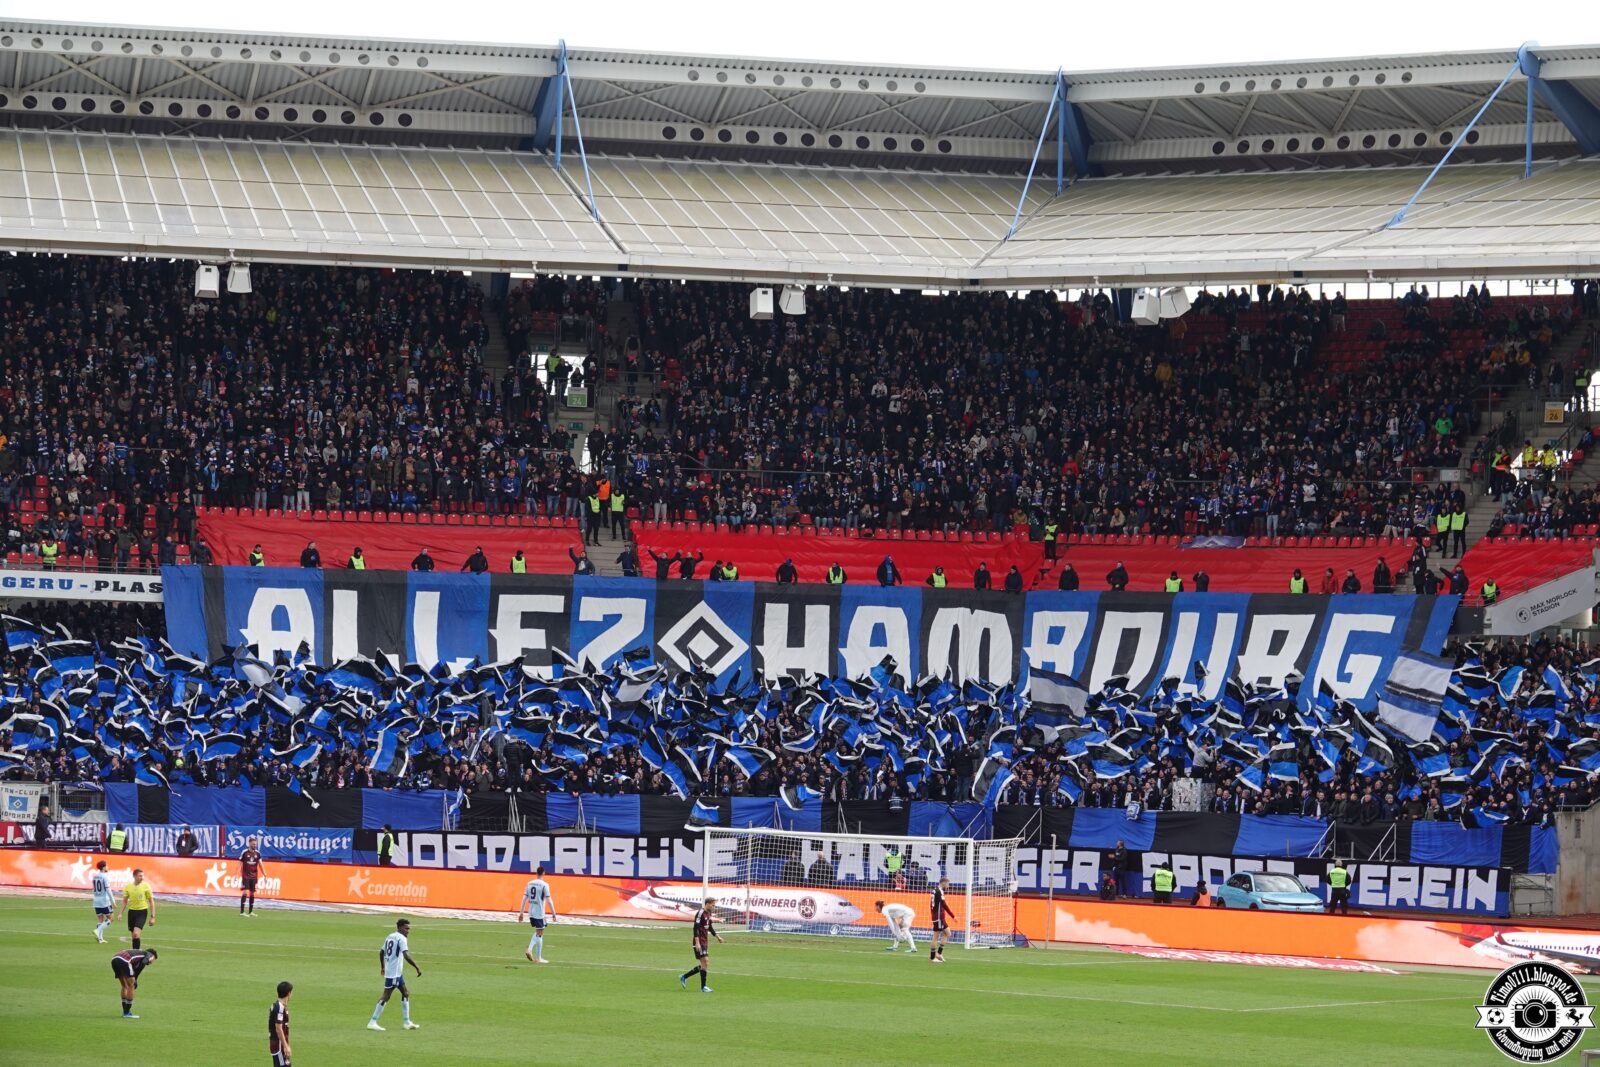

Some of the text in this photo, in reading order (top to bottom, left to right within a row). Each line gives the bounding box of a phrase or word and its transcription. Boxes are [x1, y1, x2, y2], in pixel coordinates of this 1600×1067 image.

[1549, 412, 1559, 420] 26
[1530, 588, 1578, 611] MAX MORLOCK
[1532, 601, 1561, 617] STADION
[239, 587, 1396, 701] ALLEZ HAMBOURG
[377, 832, 738, 878] NORDTRIBÜNE
[367, 881, 427, 898] corendon
[530, 886, 537, 900] 9
